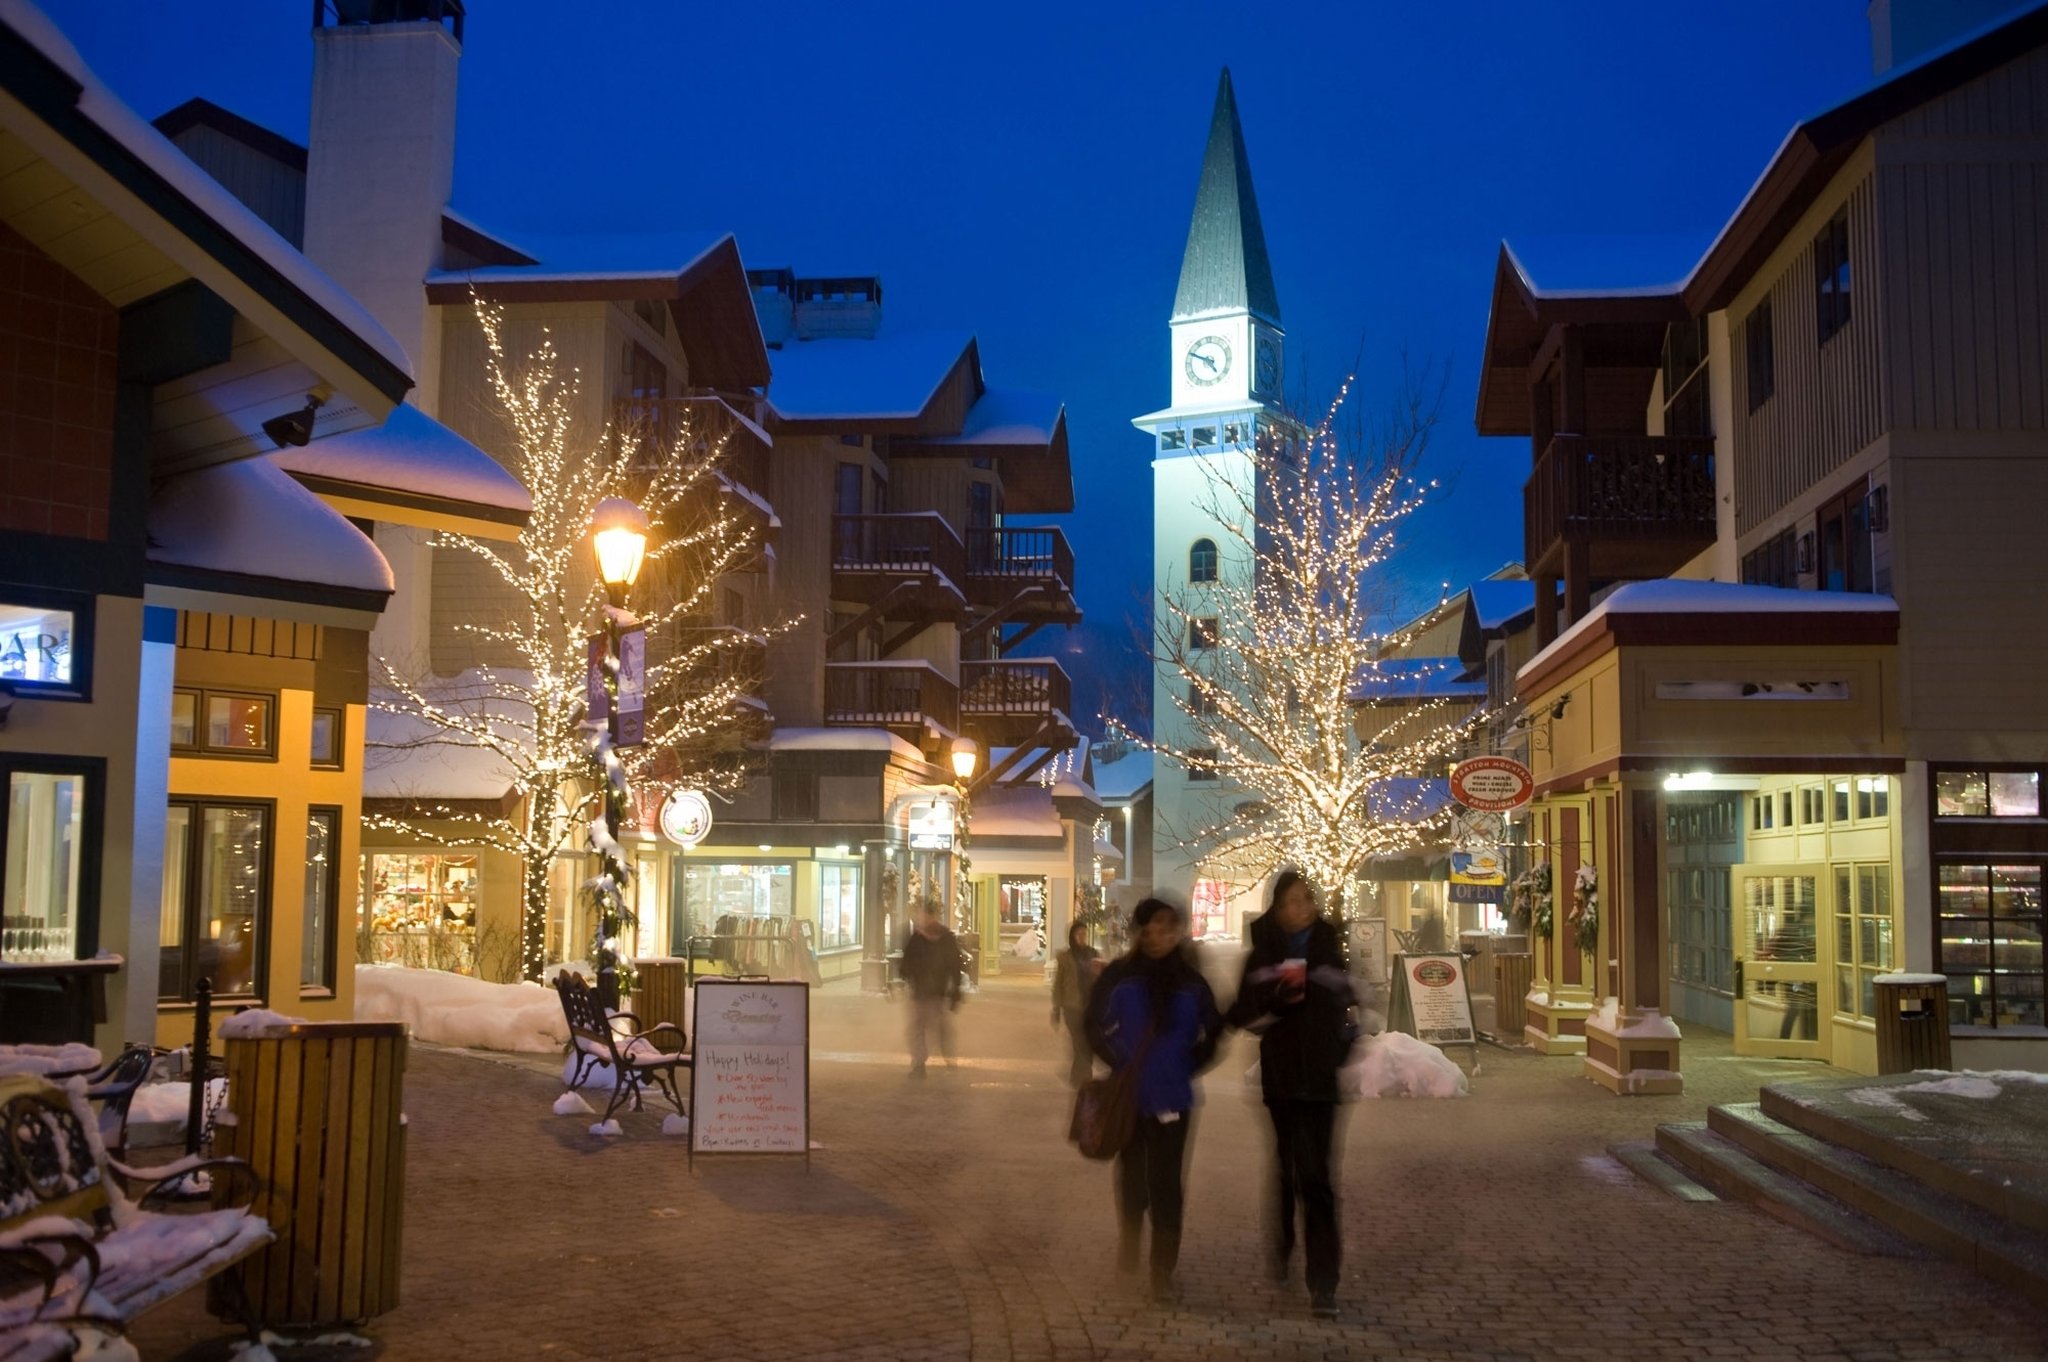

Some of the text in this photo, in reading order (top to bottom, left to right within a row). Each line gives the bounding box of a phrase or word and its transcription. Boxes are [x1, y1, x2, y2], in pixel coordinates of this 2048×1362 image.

[0, 633, 59, 664] AR
[1453, 761, 1532, 785] STRATTON MOUNTAIN
[1468, 797, 1517, 809] PROVISIONS
[1456, 884, 1496, 900] OPEN
[731, 991, 779, 1010] WINE BAR
[706, 1049, 790, 1073] Happy Holidays!
